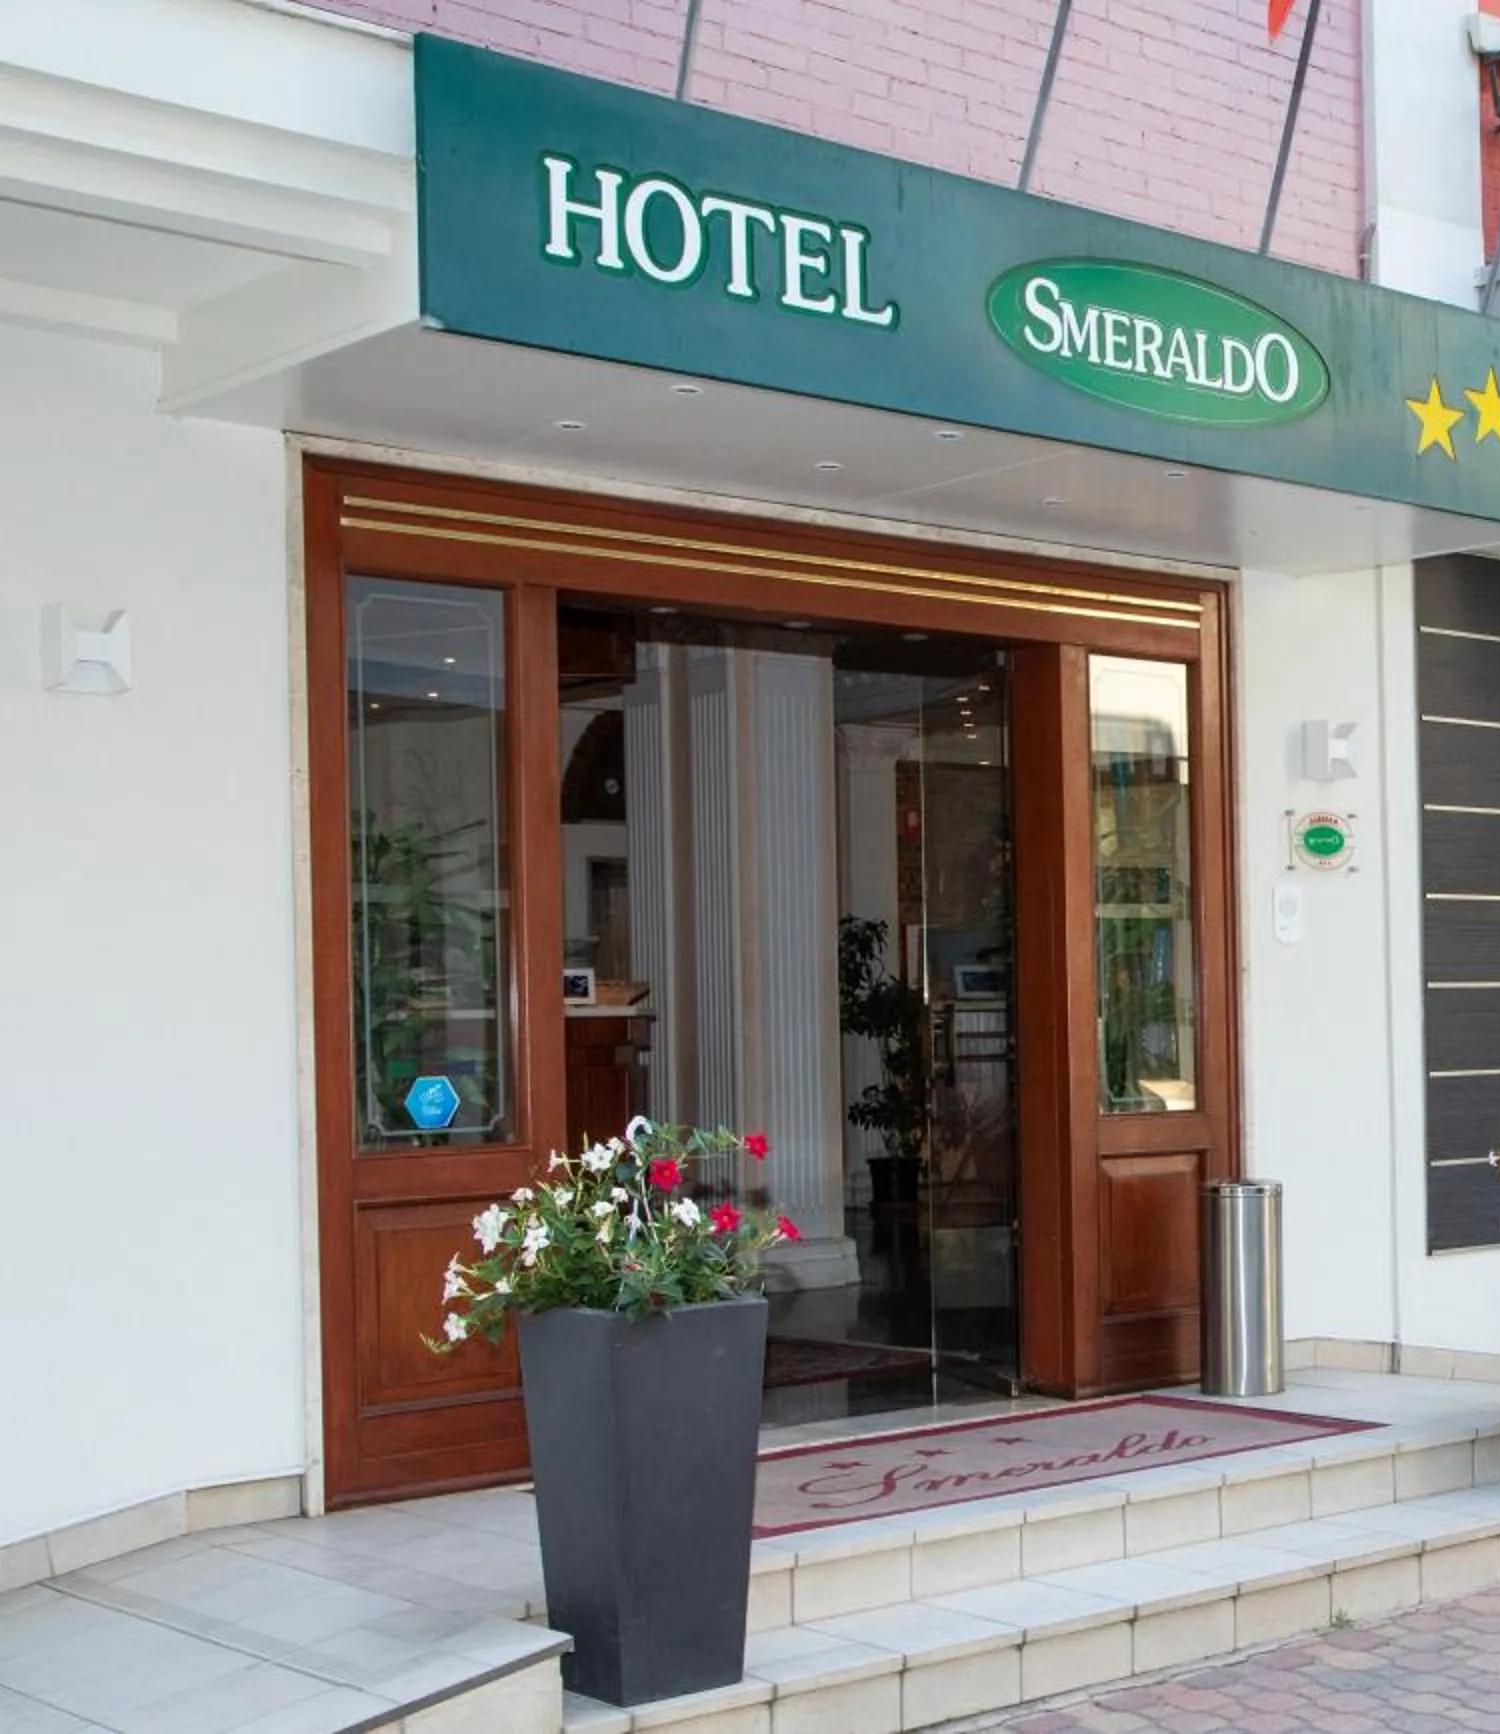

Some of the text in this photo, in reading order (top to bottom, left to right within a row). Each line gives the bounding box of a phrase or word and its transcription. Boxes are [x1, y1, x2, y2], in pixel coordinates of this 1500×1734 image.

[543, 156, 1299, 402] HOTEL SMERALDO
[798, 1429, 1216, 1508] Smeraldo
